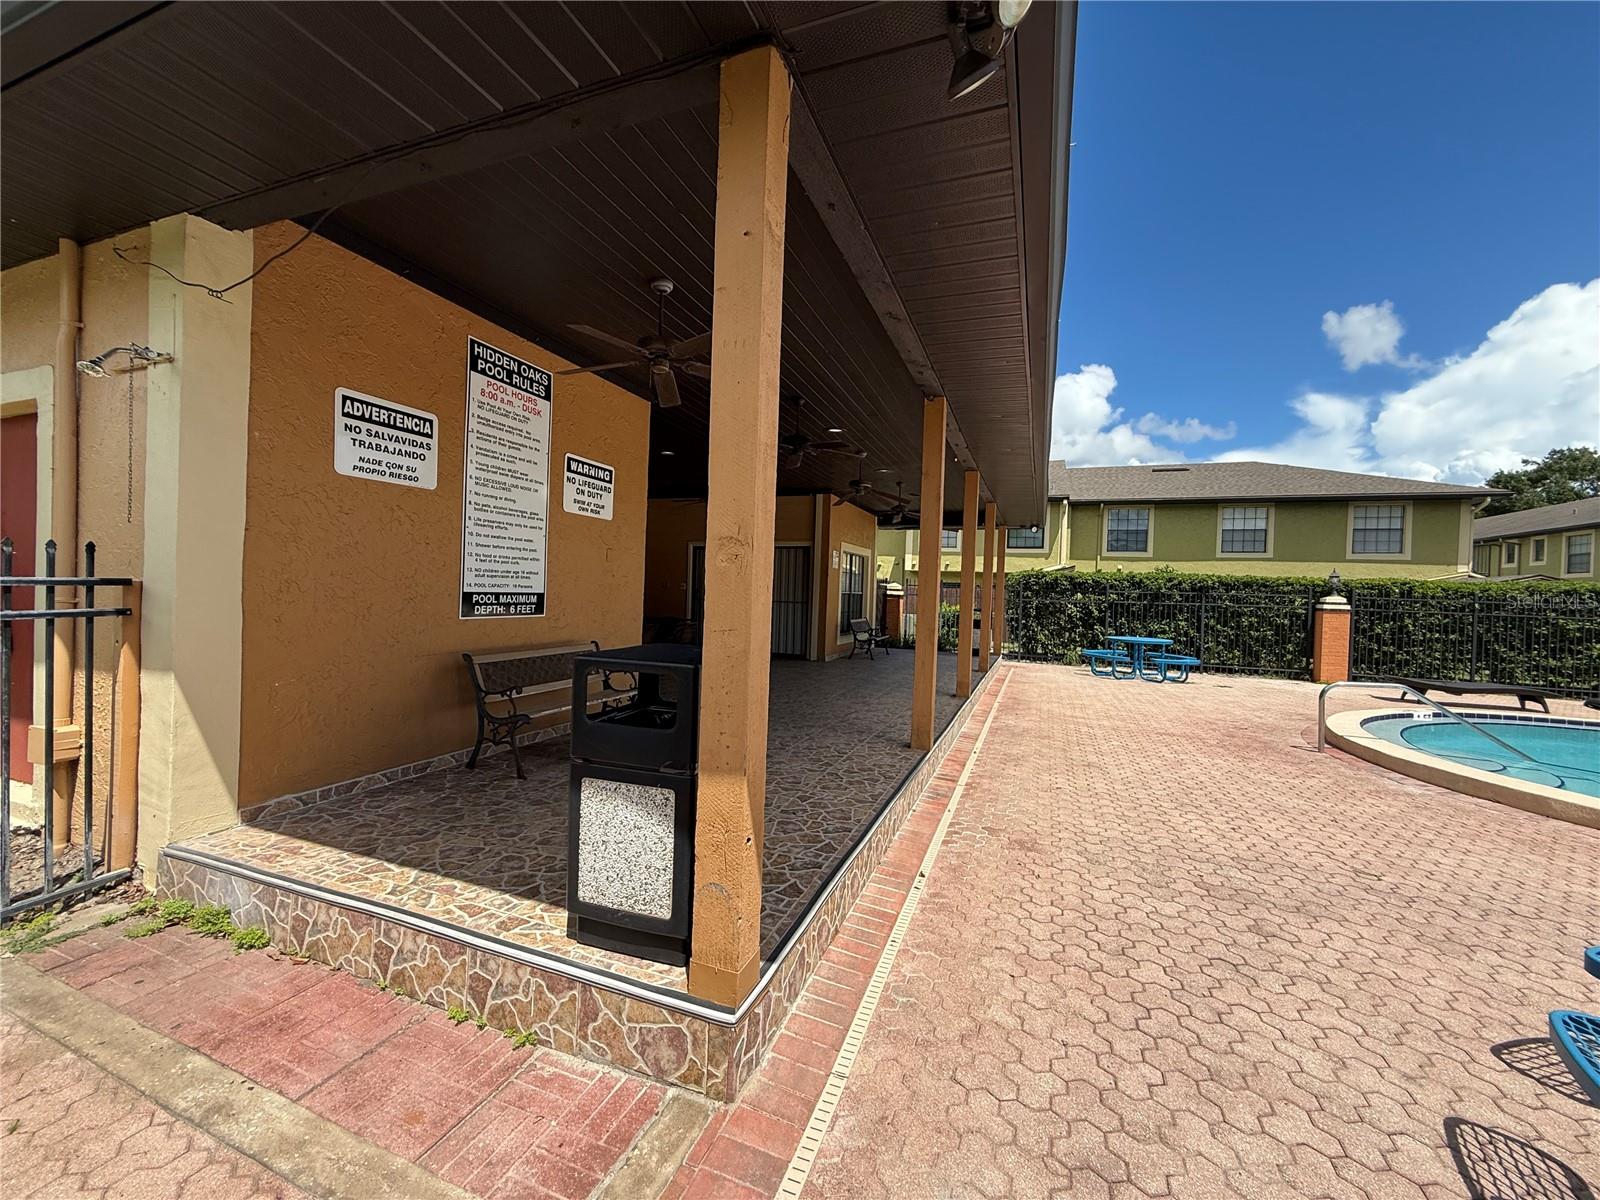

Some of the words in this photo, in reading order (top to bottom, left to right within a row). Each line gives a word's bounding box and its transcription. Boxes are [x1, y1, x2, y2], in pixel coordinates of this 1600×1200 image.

[474, 343, 518, 373] HIDDEN
[521, 364, 548, 386] OAKS
[478, 359, 510, 383] POOL
[513, 374, 545, 397] RULES
[480, 388, 498, 402] 8:00
[500, 395, 516, 408] a.m.
[522, 403, 542, 418] DUSK
[487, 380, 510, 396] POOL
[512, 390, 538, 407] HOURS
[344, 400, 432, 434] ADVERTENCIA
[486, 407, 510, 419] LIFEGUARD
[344, 422, 362, 434] NO
[366, 428, 432, 451] SALVAVIDAS
[350, 438, 426, 462] TRABAJANDO
[358, 456, 383, 467] NADE
[570, 460, 610, 480] WARNING
[352, 465, 386, 477] PROPIO
[388, 472, 419, 482] RIESGO
[567, 476, 576, 484] NO
[578, 479, 612, 494] LIFEGUARD
[576, 488, 585, 496] ON
[587, 490, 603, 500] DUTY
[472, 594, 497, 603] POOL
[499, 595, 537, 604] MAXIMUM
[475, 605, 506, 614] DEPTH:
[510, 605, 515, 614] 6
[517, 605, 535, 614] FEET
